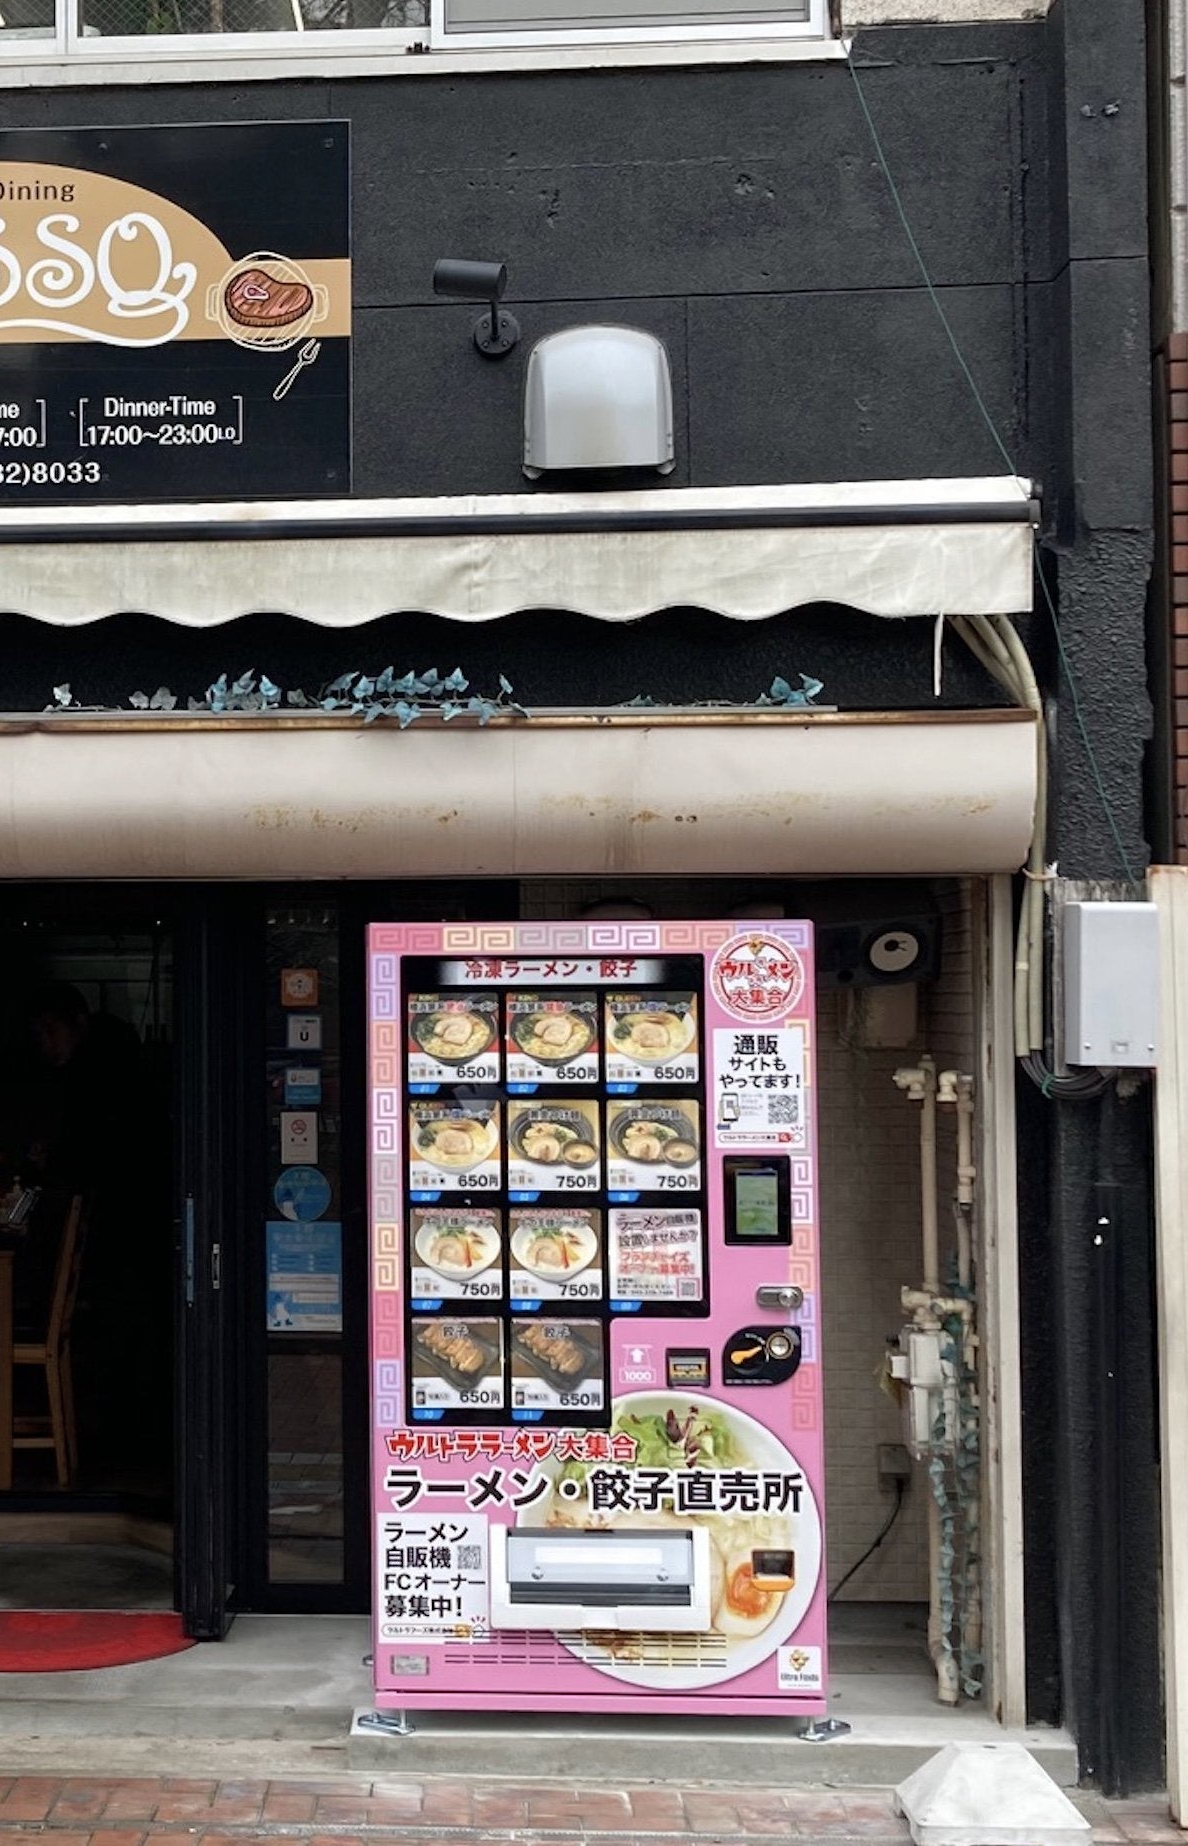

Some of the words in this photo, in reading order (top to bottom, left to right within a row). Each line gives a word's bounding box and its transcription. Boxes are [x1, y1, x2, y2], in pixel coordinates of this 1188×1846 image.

[103, 396, 216, 418] Dinner-Time
[464, 959, 638, 980] 冷凍ラーメン・餃子
[733, 1033, 779, 1055] 通販
[729, 1056, 787, 1071] サイトも
[456, 1066, 497, 1079] 650円
[556, 1066, 597, 1080] 650円
[654, 1066, 695, 1080] 650円
[457, 1174, 499, 1188] 650円
[556, 1175, 597, 1189] 750円
[657, 1174, 699, 1188] 750円
[460, 1282, 501, 1296] 750円
[558, 1283, 600, 1297] 750円
[623, 1371, 653, 1382] 1000
[460, 1391, 501, 1405] 650円
[559, 1392, 601, 1407] 650円
[384, 1468, 804, 1513] ラーメン・餃子直売所
[384, 1521, 469, 1543] ラーメン
[385, 1546, 451, 1569] 自販機
[384, 1573, 486, 1591] FCオーナー
